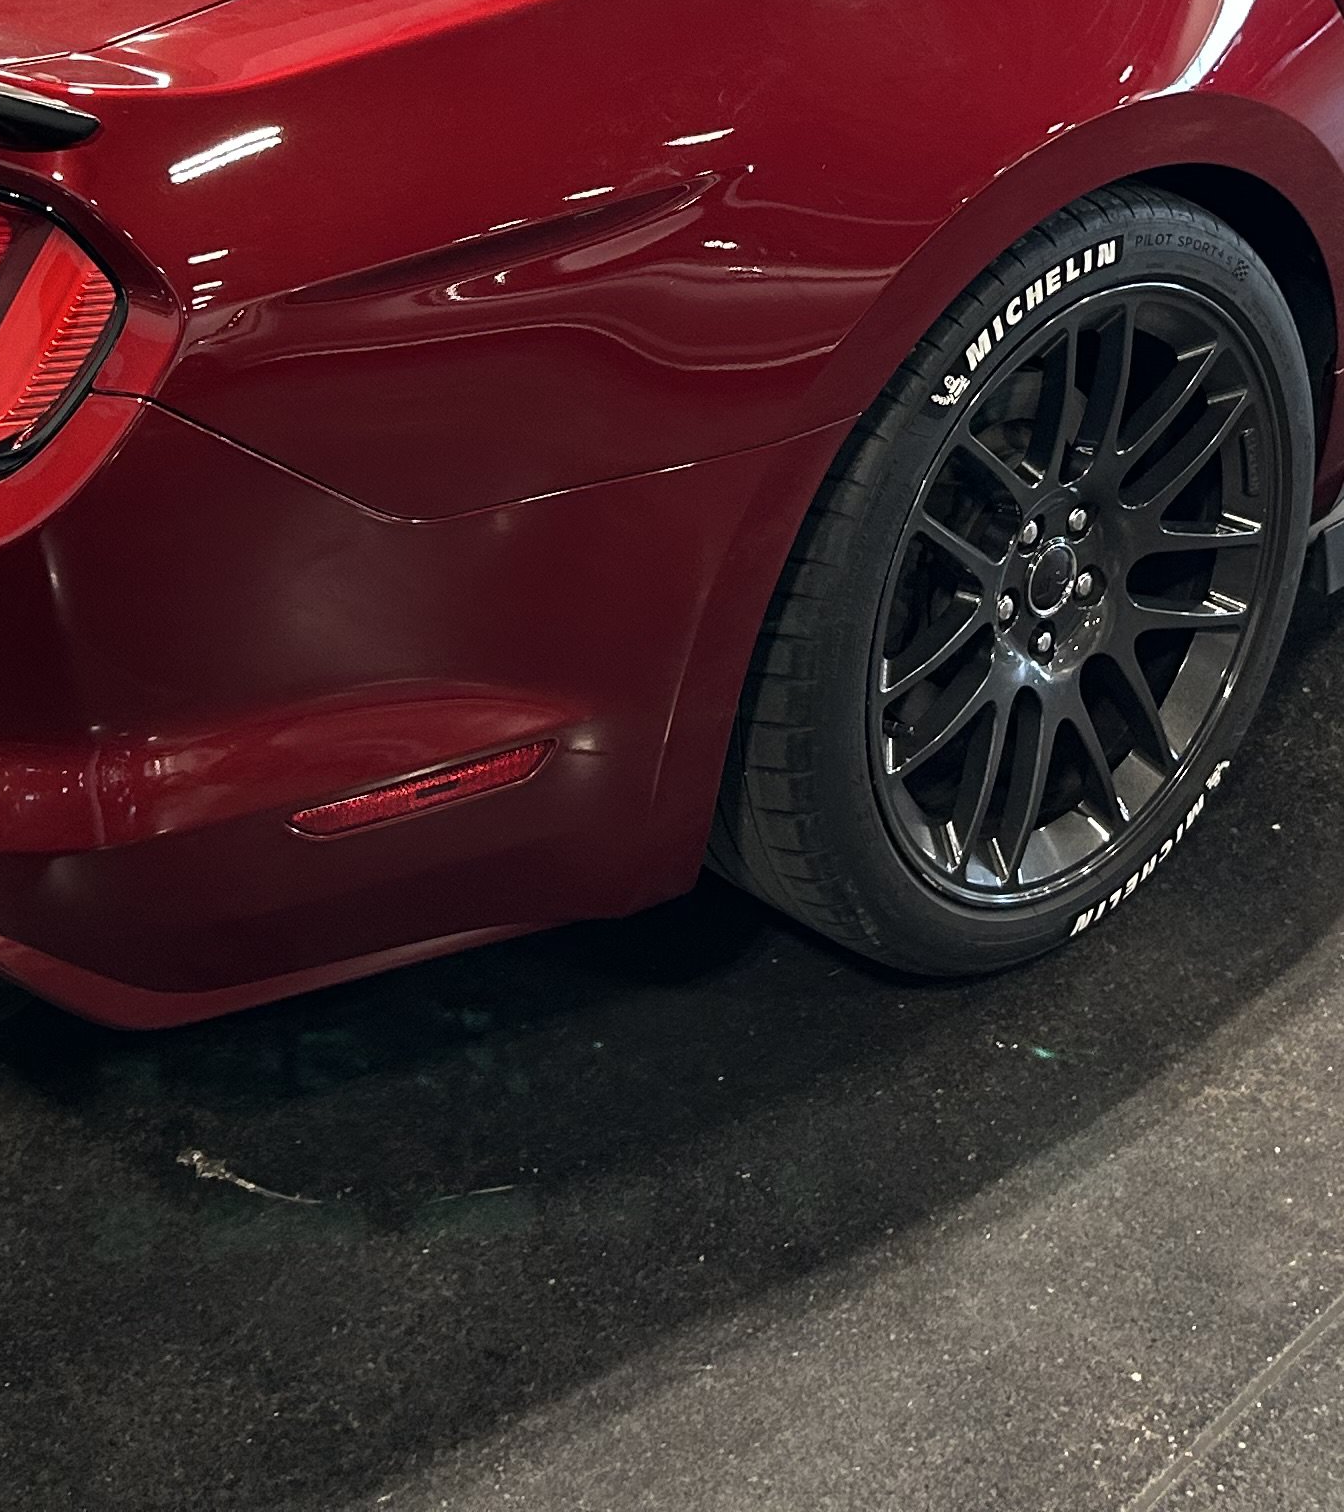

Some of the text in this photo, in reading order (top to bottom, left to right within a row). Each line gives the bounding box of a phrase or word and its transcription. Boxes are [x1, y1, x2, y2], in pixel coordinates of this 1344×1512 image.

[964, 240, 1117, 371] MICHELIN
[1135, 233, 1173, 246] PILOT
[1177, 235, 1218, 257] SPORT
[1226, 255, 1233, 265] S
[1069, 793, 1205, 937] MICHELIN
